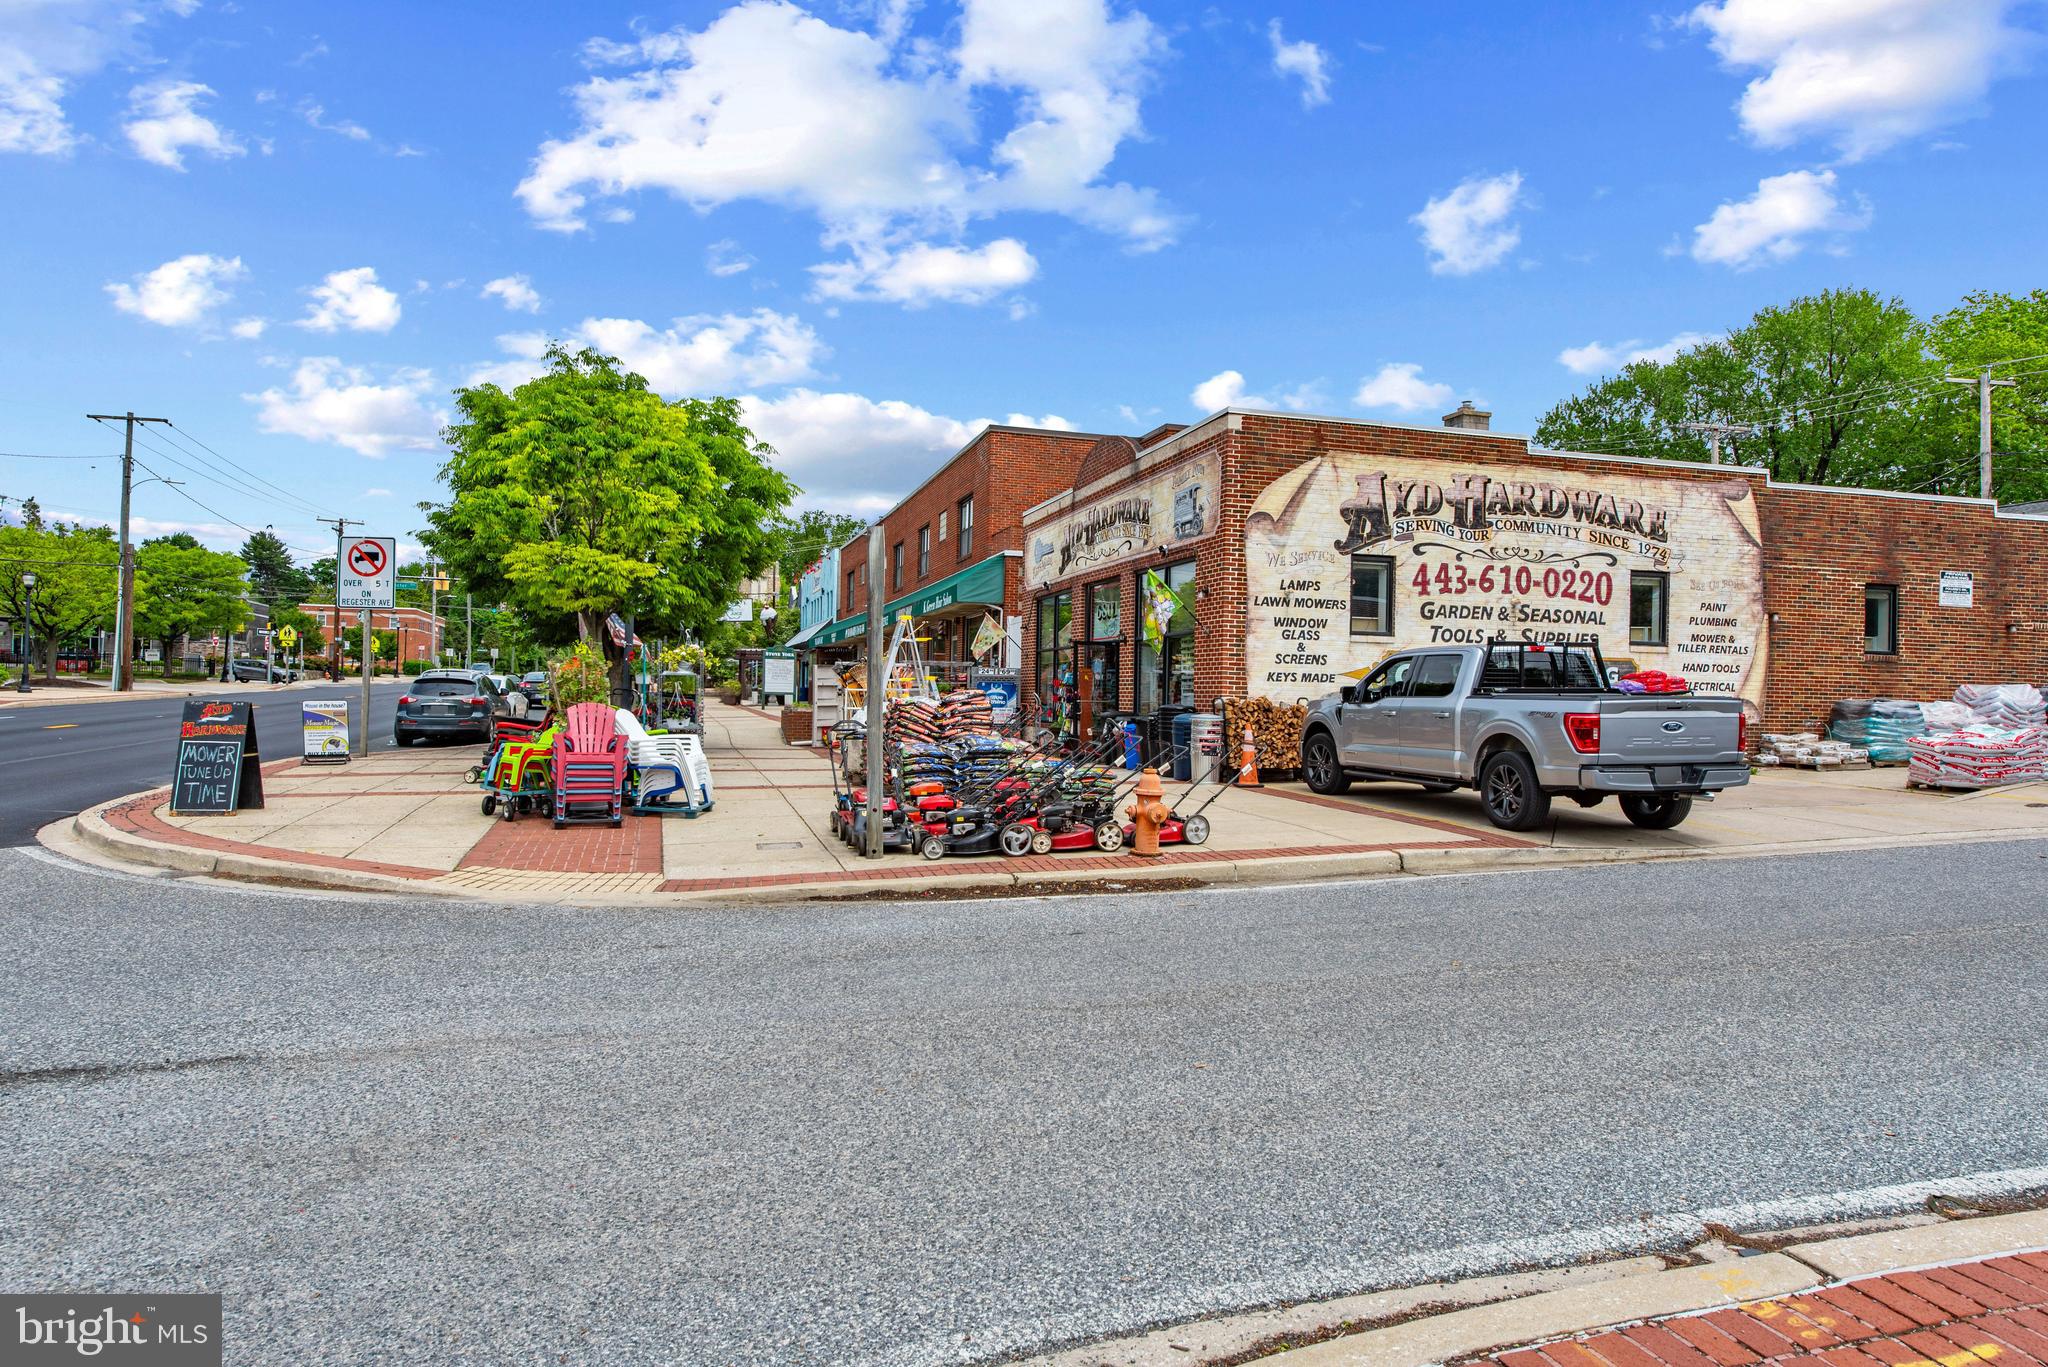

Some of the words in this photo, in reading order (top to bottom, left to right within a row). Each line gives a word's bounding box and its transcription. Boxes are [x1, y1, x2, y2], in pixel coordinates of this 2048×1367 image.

[1334, 470, 1444, 556] AYD
[1445, 473, 1669, 544] HARDWARE
[1059, 521, 1084, 576] AYD
[1084, 496, 1151, 547] HARDWARE
[1395, 519, 1455, 538] SERVING
[1459, 528, 1490, 542] YOUR
[1494, 518, 1582, 540] COMMUNITY
[1589, 530, 1630, 550] SINCE
[1638, 542, 1668, 562] 1974
[343, 579, 363, 587] OVER
[375, 580, 381, 588] 5
[385, 580, 390, 588] T
[1279, 579, 1321, 592] LAMPS
[1412, 561, 1614, 607] 443-610-0220
[361, 590, 372, 598] ON
[341, 598, 376, 606] REGESTER
[378, 599, 391, 607] AVE
[1253, 595, 1291, 608] LAWN
[1293, 597, 1347, 610] MOWERS
[1699, 602, 1728, 613] PAINT
[1420, 601, 1494, 621] GARDEN
[1497, 606, 1510, 622] &
[1517, 604, 1607, 626] SEASONAL
[1273, 616, 1329, 629] WINDOW
[1688, 616, 1738, 628] PLUMBING
[1281, 629, 1321, 641] GLASS
[1429, 625, 1485, 644] TOOLS
[1495, 628, 1508, 641] &
[1521, 628, 1600, 643] SUPPLIES
[1690, 633, 1726, 644] MOWER
[1728, 635, 1736, 644] &
[1296, 642, 1306, 652] &
[1677, 643, 1707, 654] TILLER
[1708, 645, 1749, 655] RENTALS
[1274, 653, 1328, 666] SCREENS
[1681, 662, 1710, 673] HAND
[1711, 663, 1741, 674] TOOLS
[1266, 671, 1298, 683] KEYS
[1300, 672, 1336, 684] MADE
[181, 721, 247, 738] HARDWARE
[183, 744, 236, 765] MOWER
[181, 763, 213, 780] TUNE
[213, 764, 232, 779] UP
[184, 781, 227, 805] TIME
